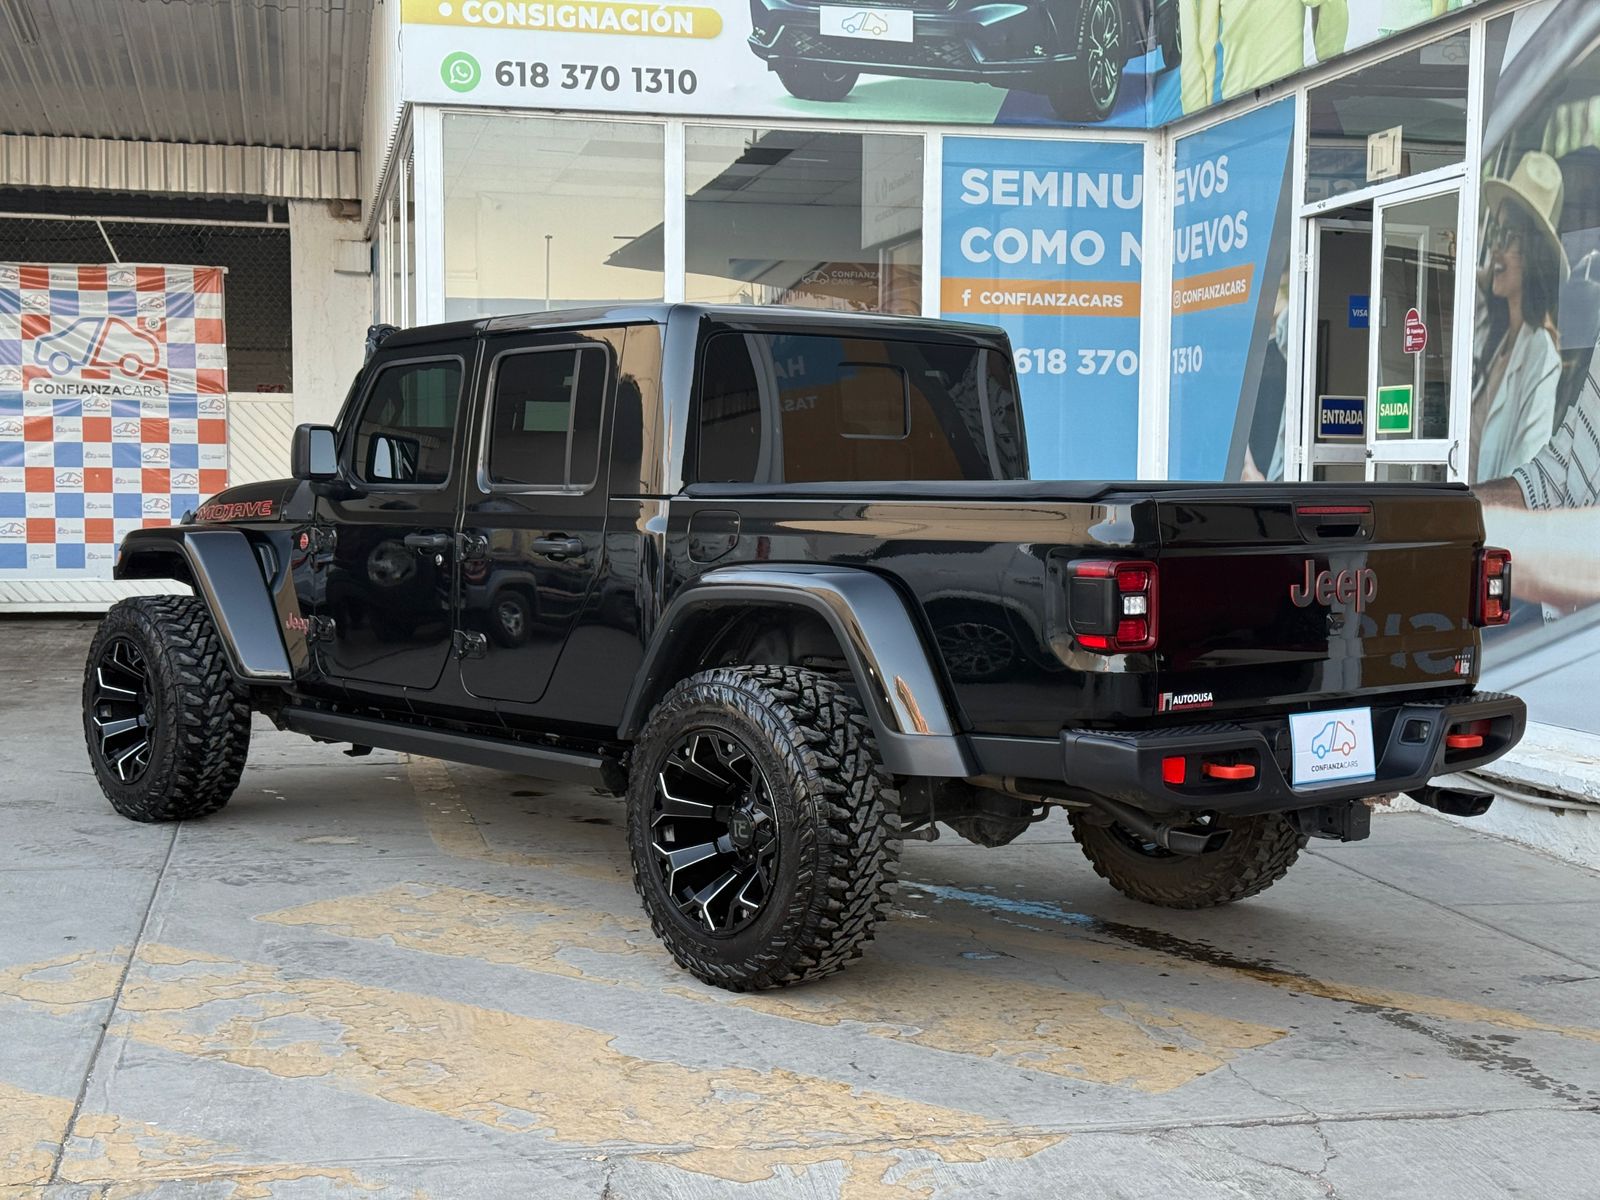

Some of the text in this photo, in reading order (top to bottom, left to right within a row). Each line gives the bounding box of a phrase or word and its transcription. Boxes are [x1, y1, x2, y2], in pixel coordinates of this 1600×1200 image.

[461, 1, 694, 34] CONSIGNACIÓN
[494, 61, 698, 95] 618 370 1310
[960, 168, 1143, 209] SEMINU
[1174, 155, 1229, 207] EVOS
[960, 226, 1106, 265] COMO
[979, 291, 1124, 308] CONFIANZACARS
[1181, 278, 1247, 305] CONFIANZACARS
[1352, 308, 1368, 317] VISA
[1014, 348, 1138, 376] 618 370
[1172, 345, 1203, 375] 1310
[33, 383, 162, 397] CONFIANZACARS
[1322, 409, 1364, 425] ENTRADA
[1380, 402, 1409, 417] SALIDA
[196, 499, 273, 521] MOJAVE
[1290, 559, 1378, 613] Jeep
[1172, 692, 1213, 705] AUTODUSA
[1311, 760, 1359, 772] CONFIANZACARS
